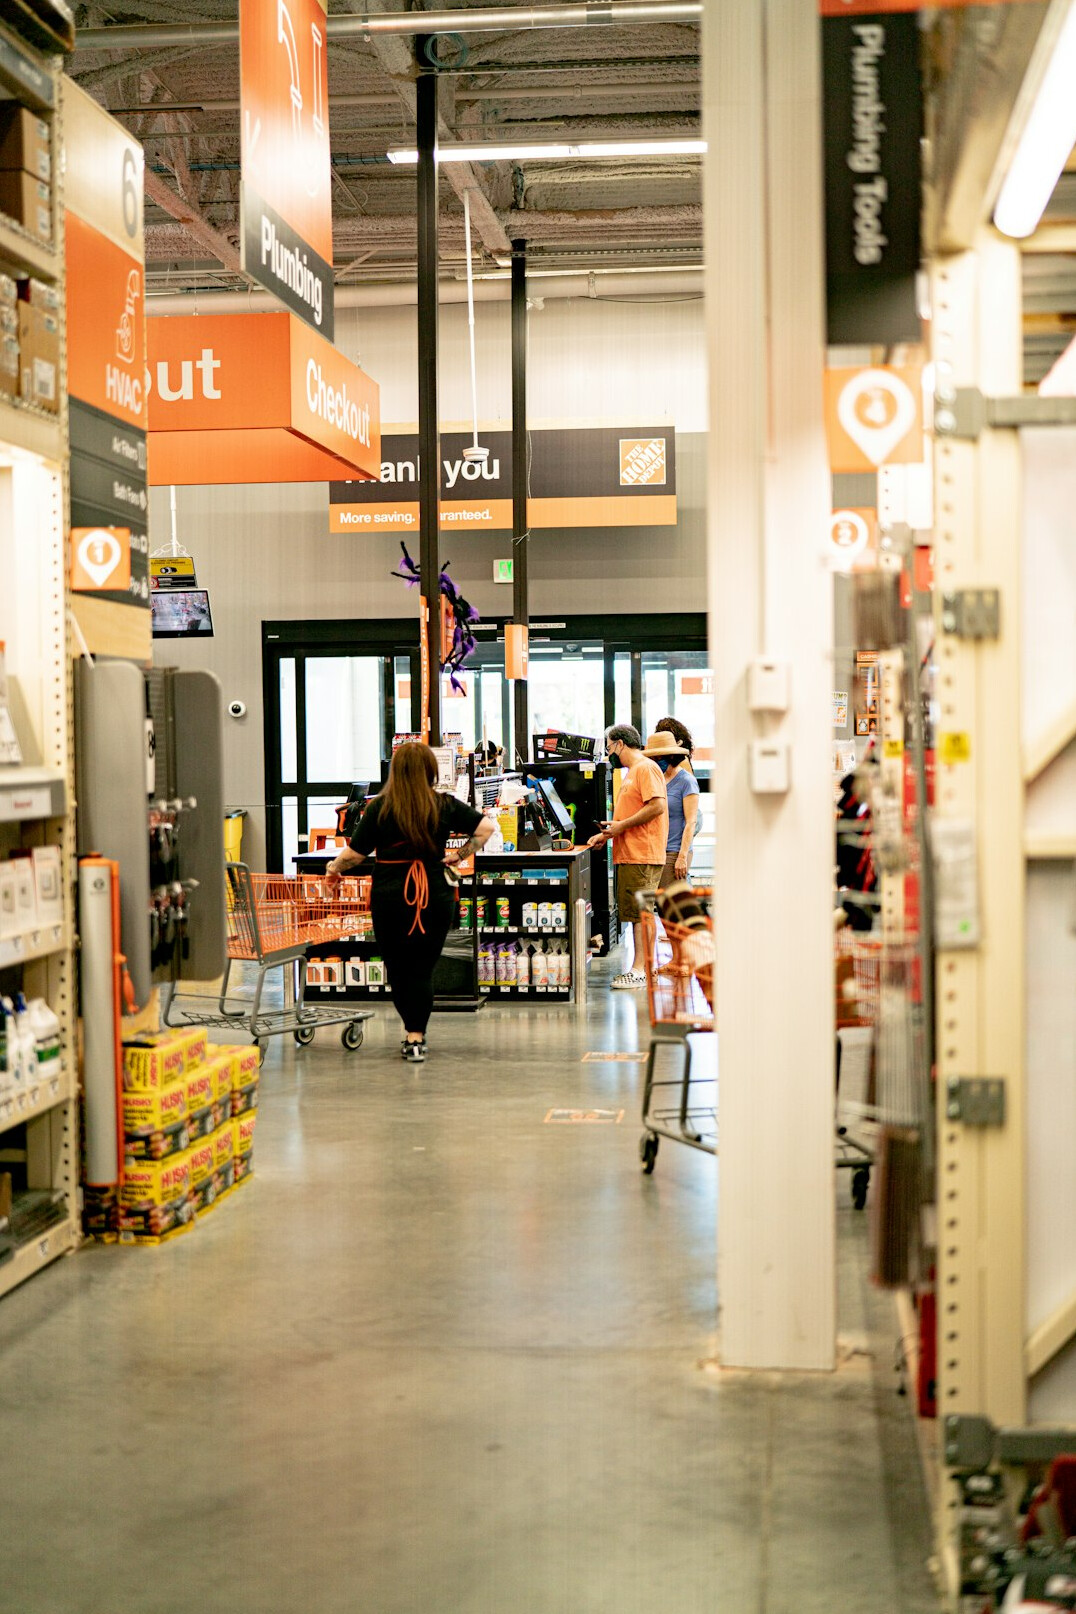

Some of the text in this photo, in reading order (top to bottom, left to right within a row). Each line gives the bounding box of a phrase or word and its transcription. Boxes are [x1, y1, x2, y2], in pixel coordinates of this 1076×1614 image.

[847, 23, 888, 265] Plumbing Tools
[122, 148, 138, 239] 6
[260, 214, 323, 326] Plumbing
[106, 363, 142, 415] HVAC
[306, 358, 371, 449] Checkout
[443, 458, 500, 488] you
[622, 440, 664, 483] HOME
[340, 512, 371, 524] More
[374, 510, 416, 525] saving.
